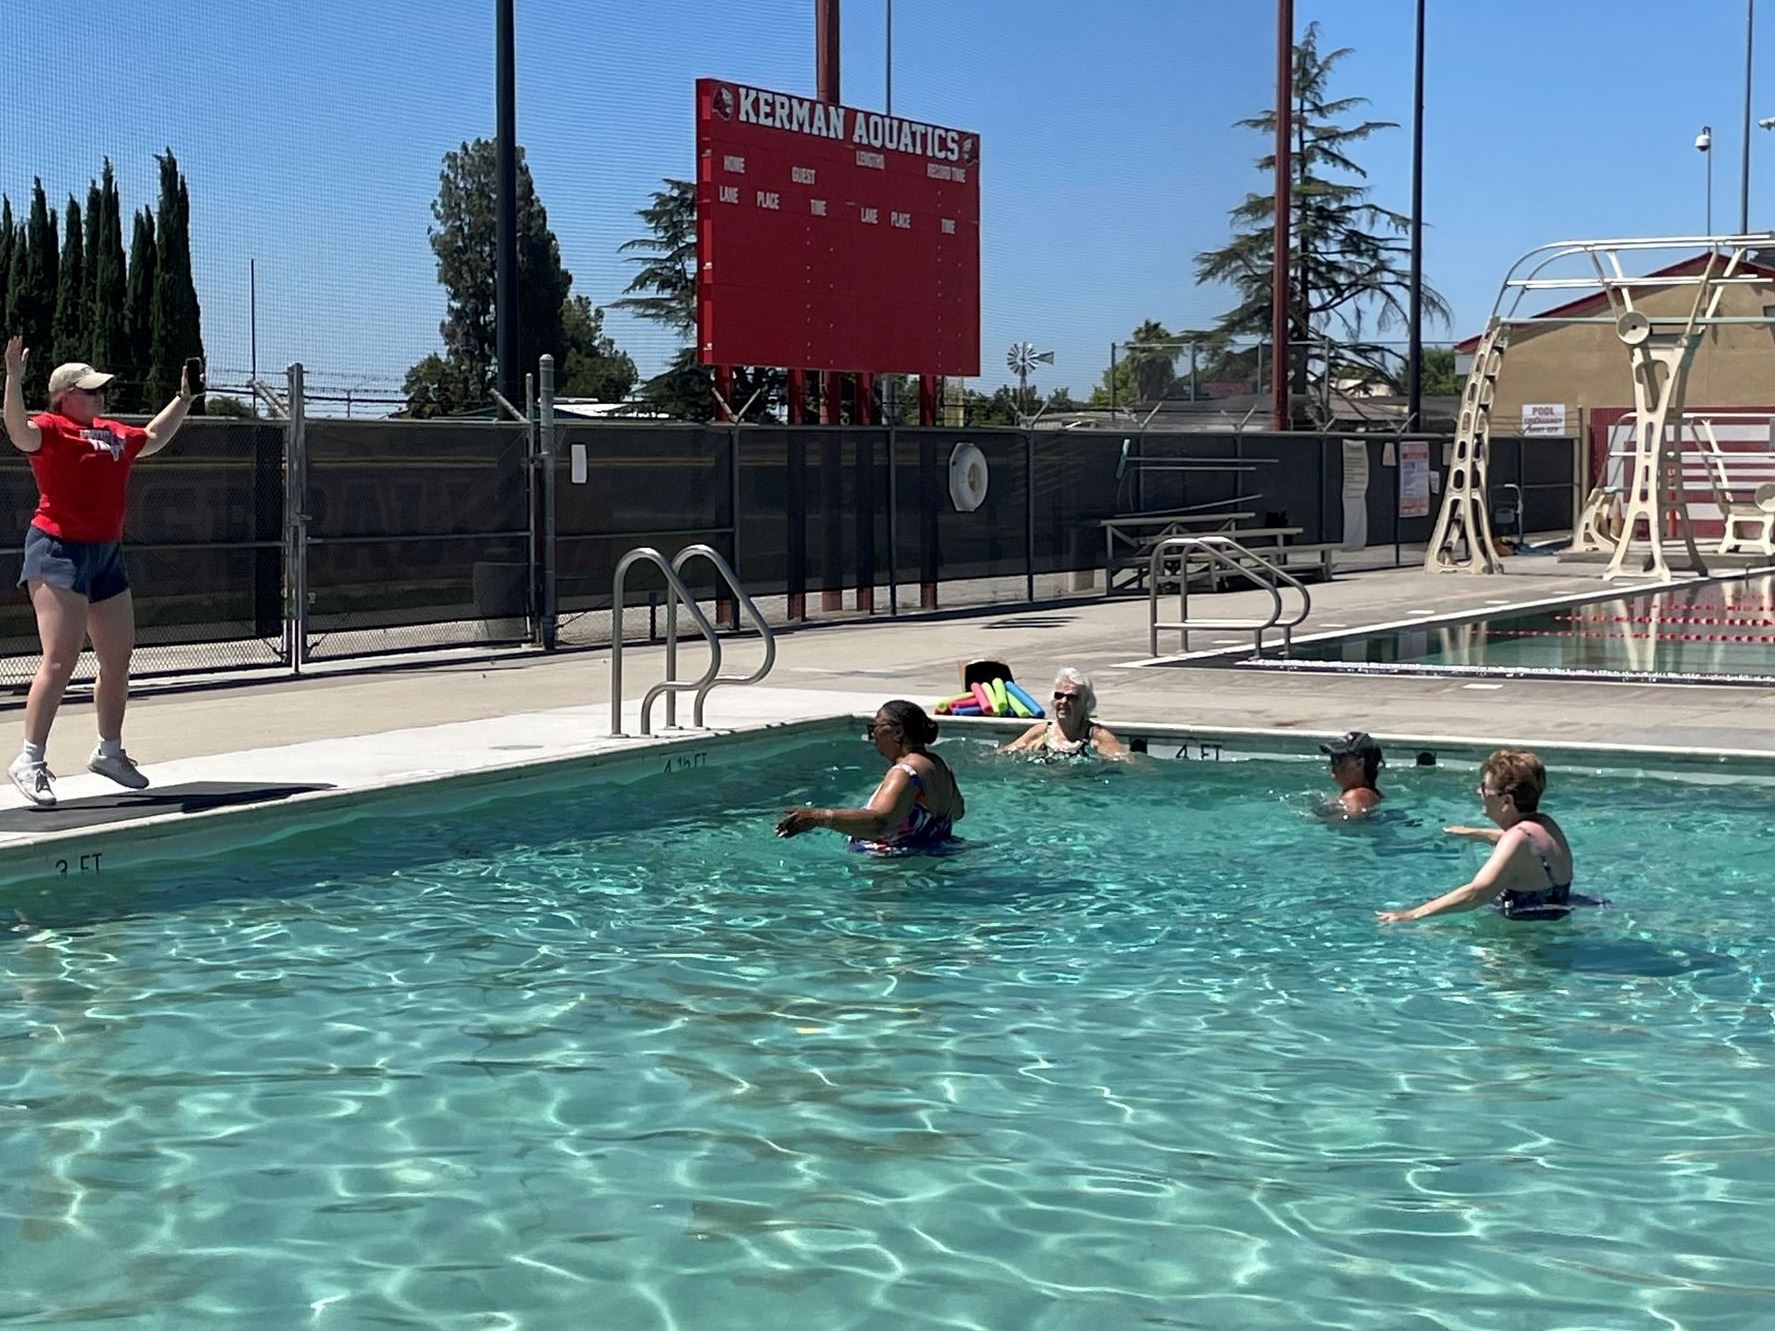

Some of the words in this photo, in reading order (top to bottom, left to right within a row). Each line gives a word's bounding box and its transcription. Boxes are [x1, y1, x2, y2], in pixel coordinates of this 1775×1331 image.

[738, 87, 845, 140] KERMAN
[852, 112, 959, 161] AQUATICS
[792, 166, 815, 185] GUEST
[719, 185, 739, 204] LANE
[757, 191, 779, 210] PLACE
[861, 207, 878, 224] LANE
[891, 211, 911, 229] PLACE
[1532, 406, 1555, 416] POOL
[1176, 744, 1189, 759] 4
[1201, 744, 1222, 760] FT
[80, 852, 103, 873] FT
